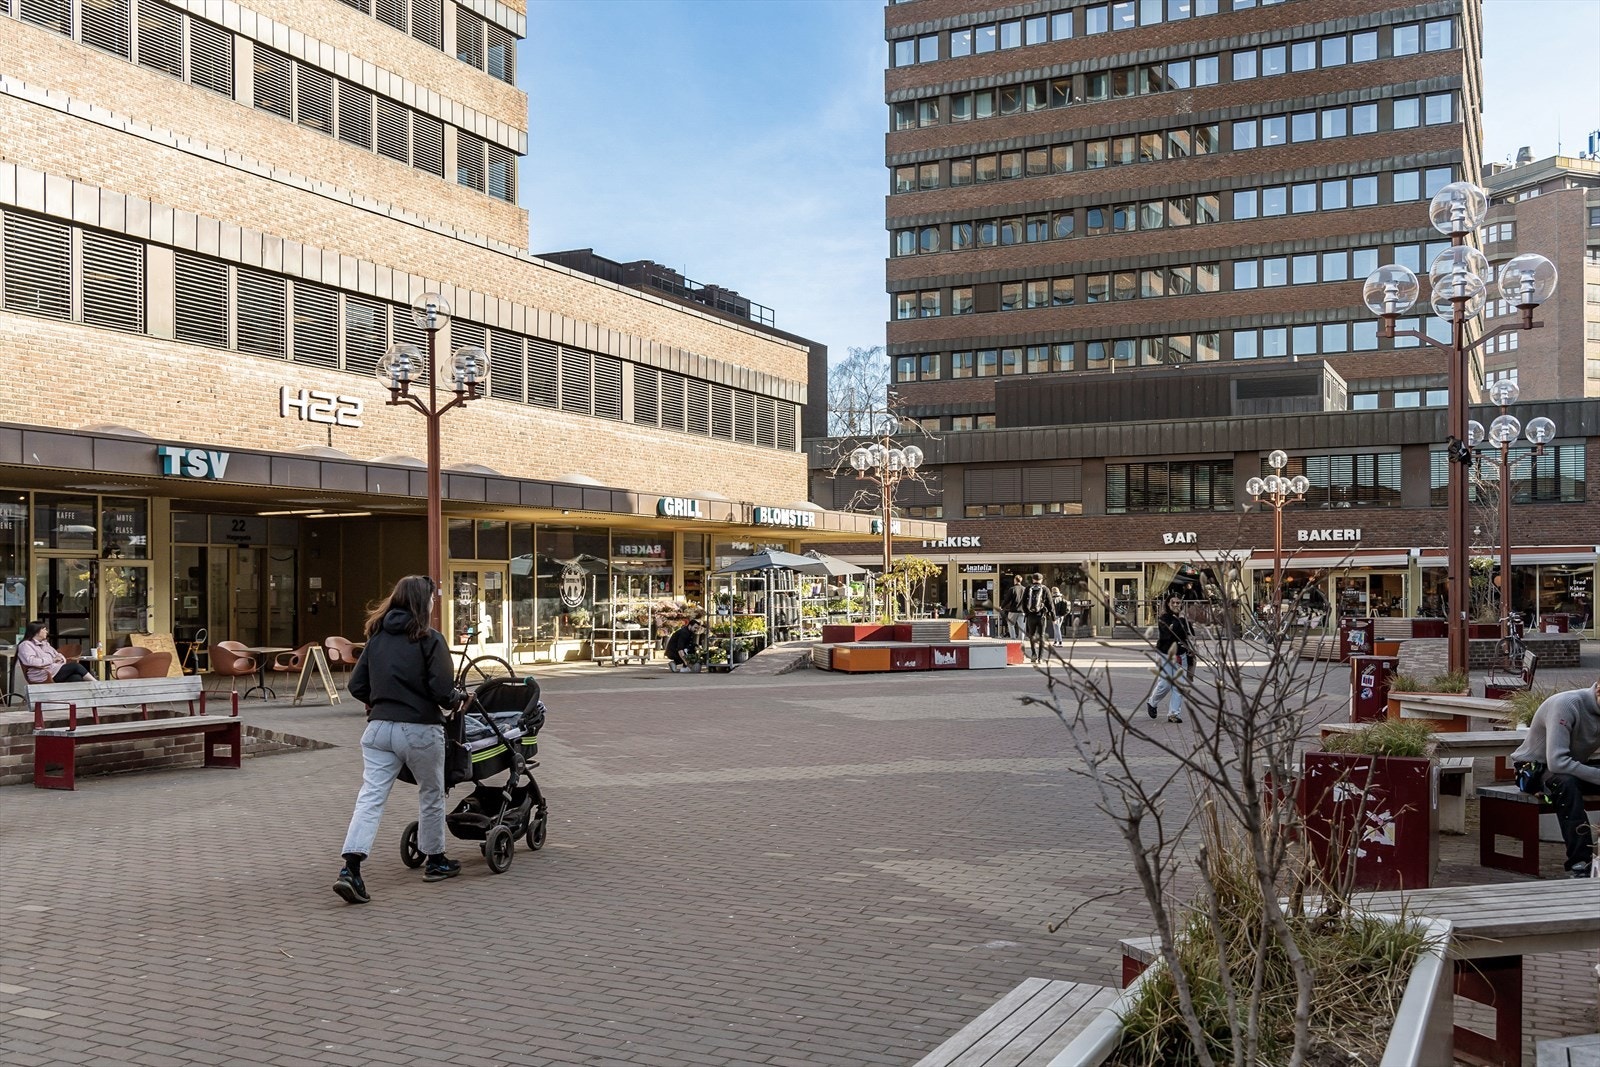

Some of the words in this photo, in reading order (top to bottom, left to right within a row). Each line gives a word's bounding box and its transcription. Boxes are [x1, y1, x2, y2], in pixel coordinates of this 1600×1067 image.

[279, 385, 364, 428] H22
[160, 445, 230, 479] TSV
[662, 497, 702, 518] GRILL
[56, 512, 75, 520] KAFFE
[760, 506, 815, 527] BLOMSTER
[231, 519, 246, 532] 22
[876, 518, 900, 534] SHI
[1162, 531, 1198, 545] BAR
[1297, 528, 1361, 542] BAKERI
[964, 564, 992, 572] Anatolia
